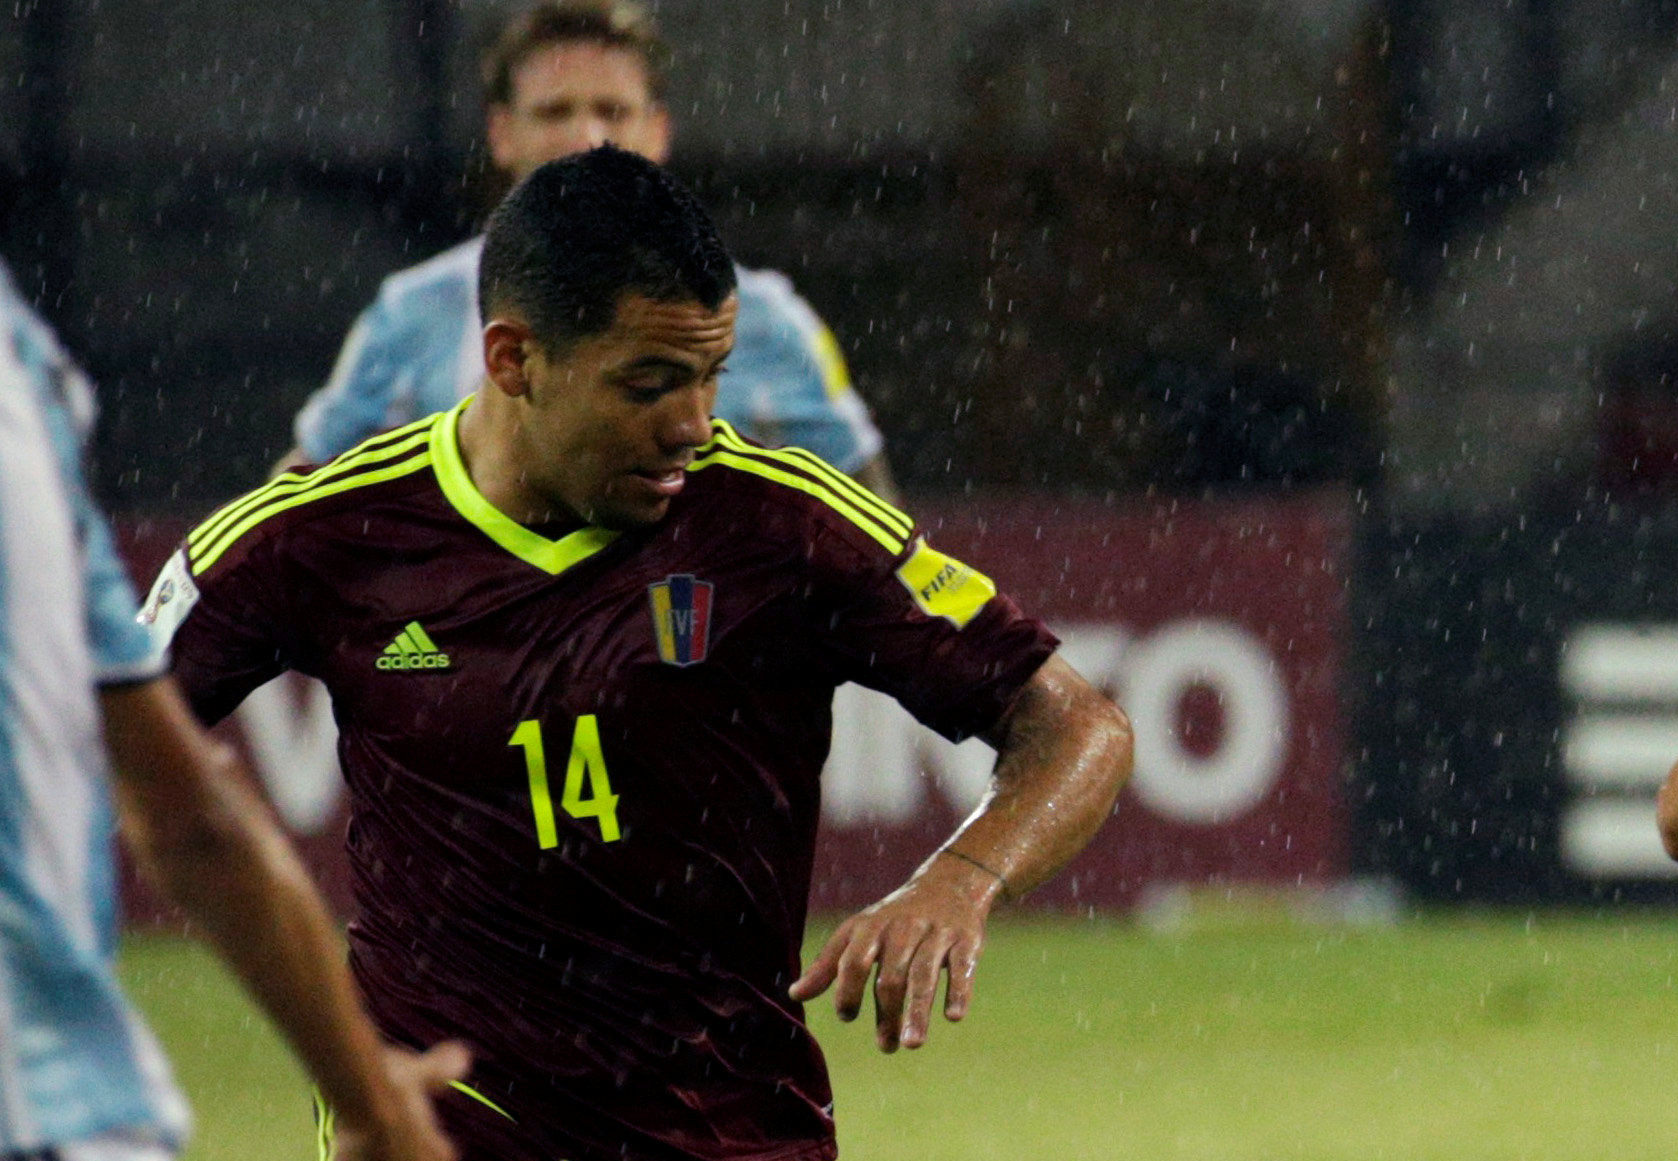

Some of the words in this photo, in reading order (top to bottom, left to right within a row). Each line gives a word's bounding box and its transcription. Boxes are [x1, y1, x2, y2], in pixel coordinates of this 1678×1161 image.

[920, 563, 957, 602] FIFA
[375, 653, 450, 670] adidas
[507, 713, 621, 850] 14
